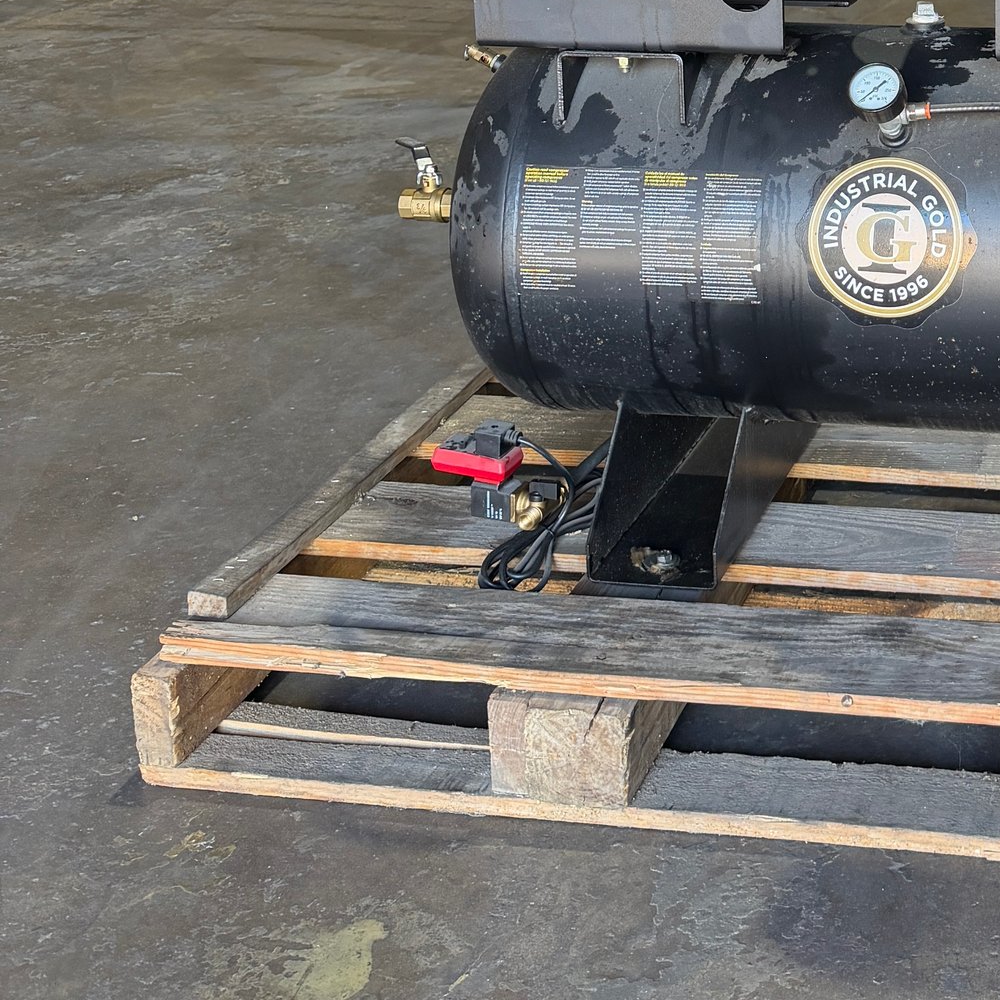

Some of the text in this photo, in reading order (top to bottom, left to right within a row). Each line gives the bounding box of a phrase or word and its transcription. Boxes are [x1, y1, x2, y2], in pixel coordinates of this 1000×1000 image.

[824, 172, 918, 248] INDUSTRIAL
[922, 195, 947, 258] GOLD
[834, 266, 929, 302] SINCE 1996
